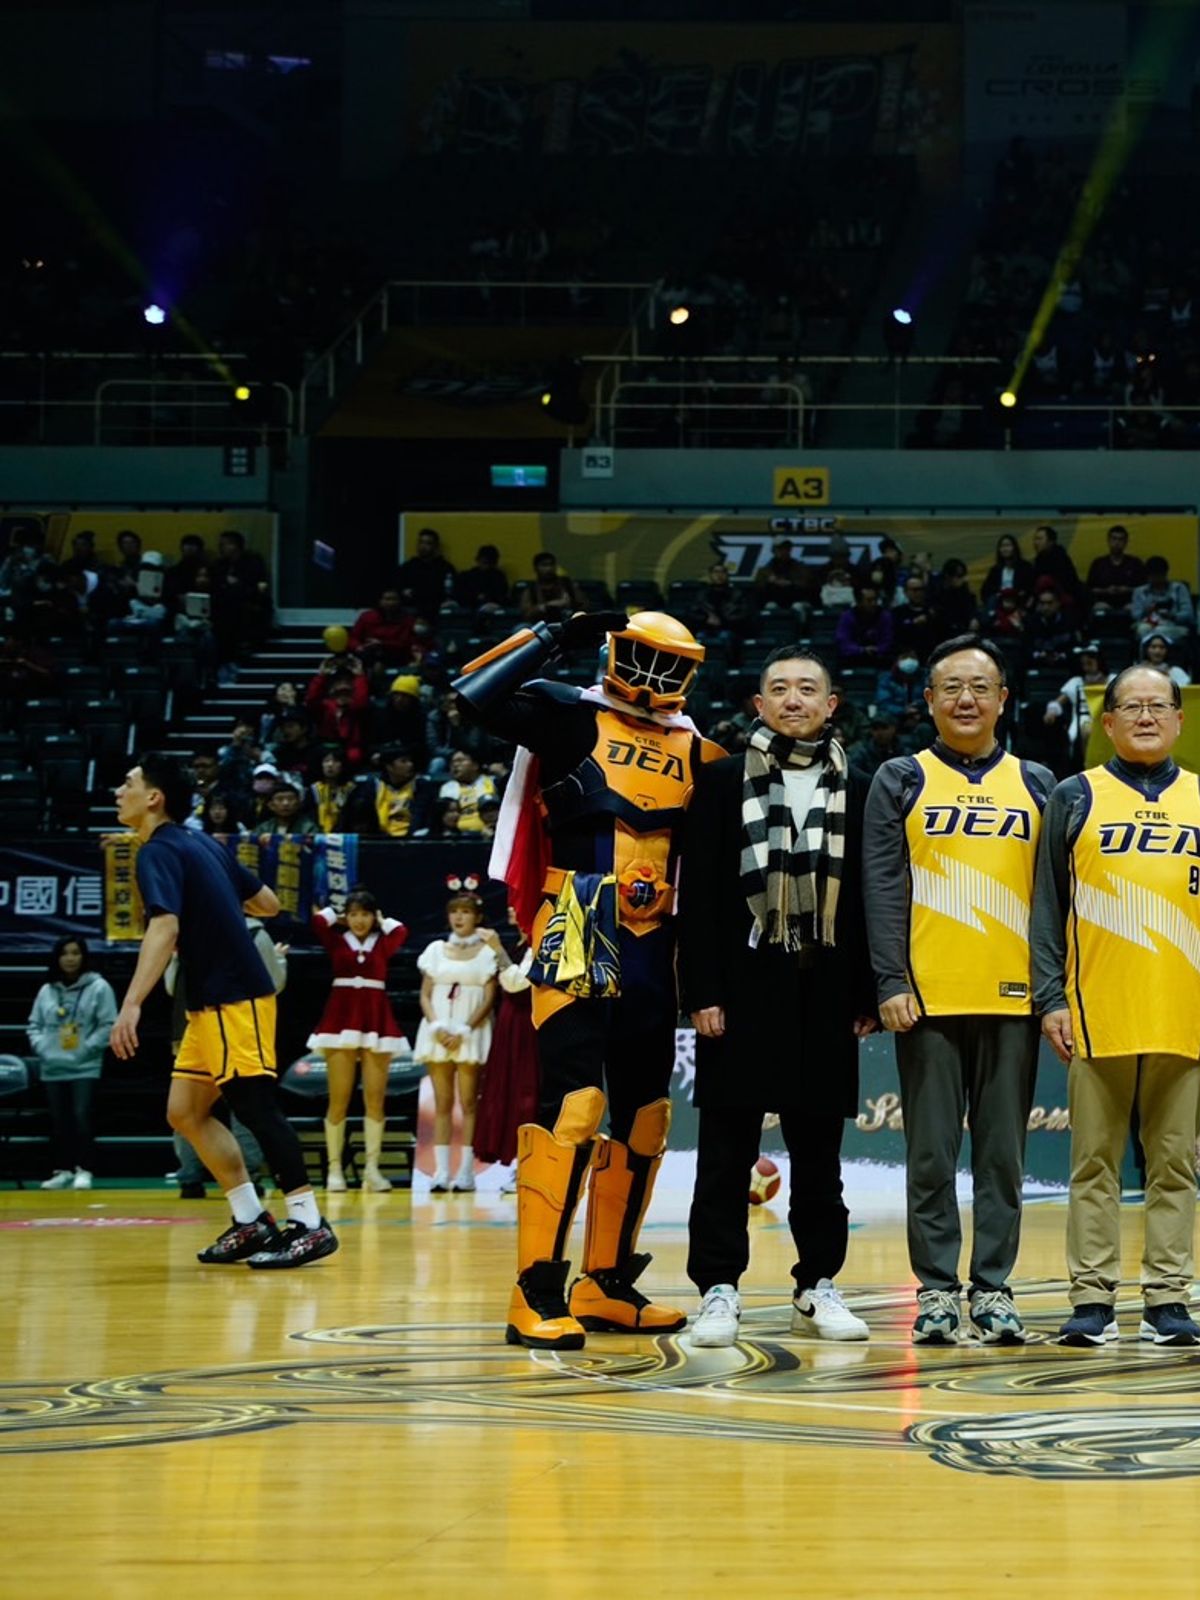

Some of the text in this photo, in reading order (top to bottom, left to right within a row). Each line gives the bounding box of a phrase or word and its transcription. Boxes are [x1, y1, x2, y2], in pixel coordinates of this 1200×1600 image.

[778, 477, 824, 500] A3
[770, 516, 836, 533] CTBC
[634, 735, 662, 749] CTBC
[606, 739, 685, 783] DEA
[955, 794, 995, 805] CTBC
[922, 805, 1031, 842] DEA
[1134, 810, 1170, 821] CTBC
[1188, 865, 1200, 896] 9
